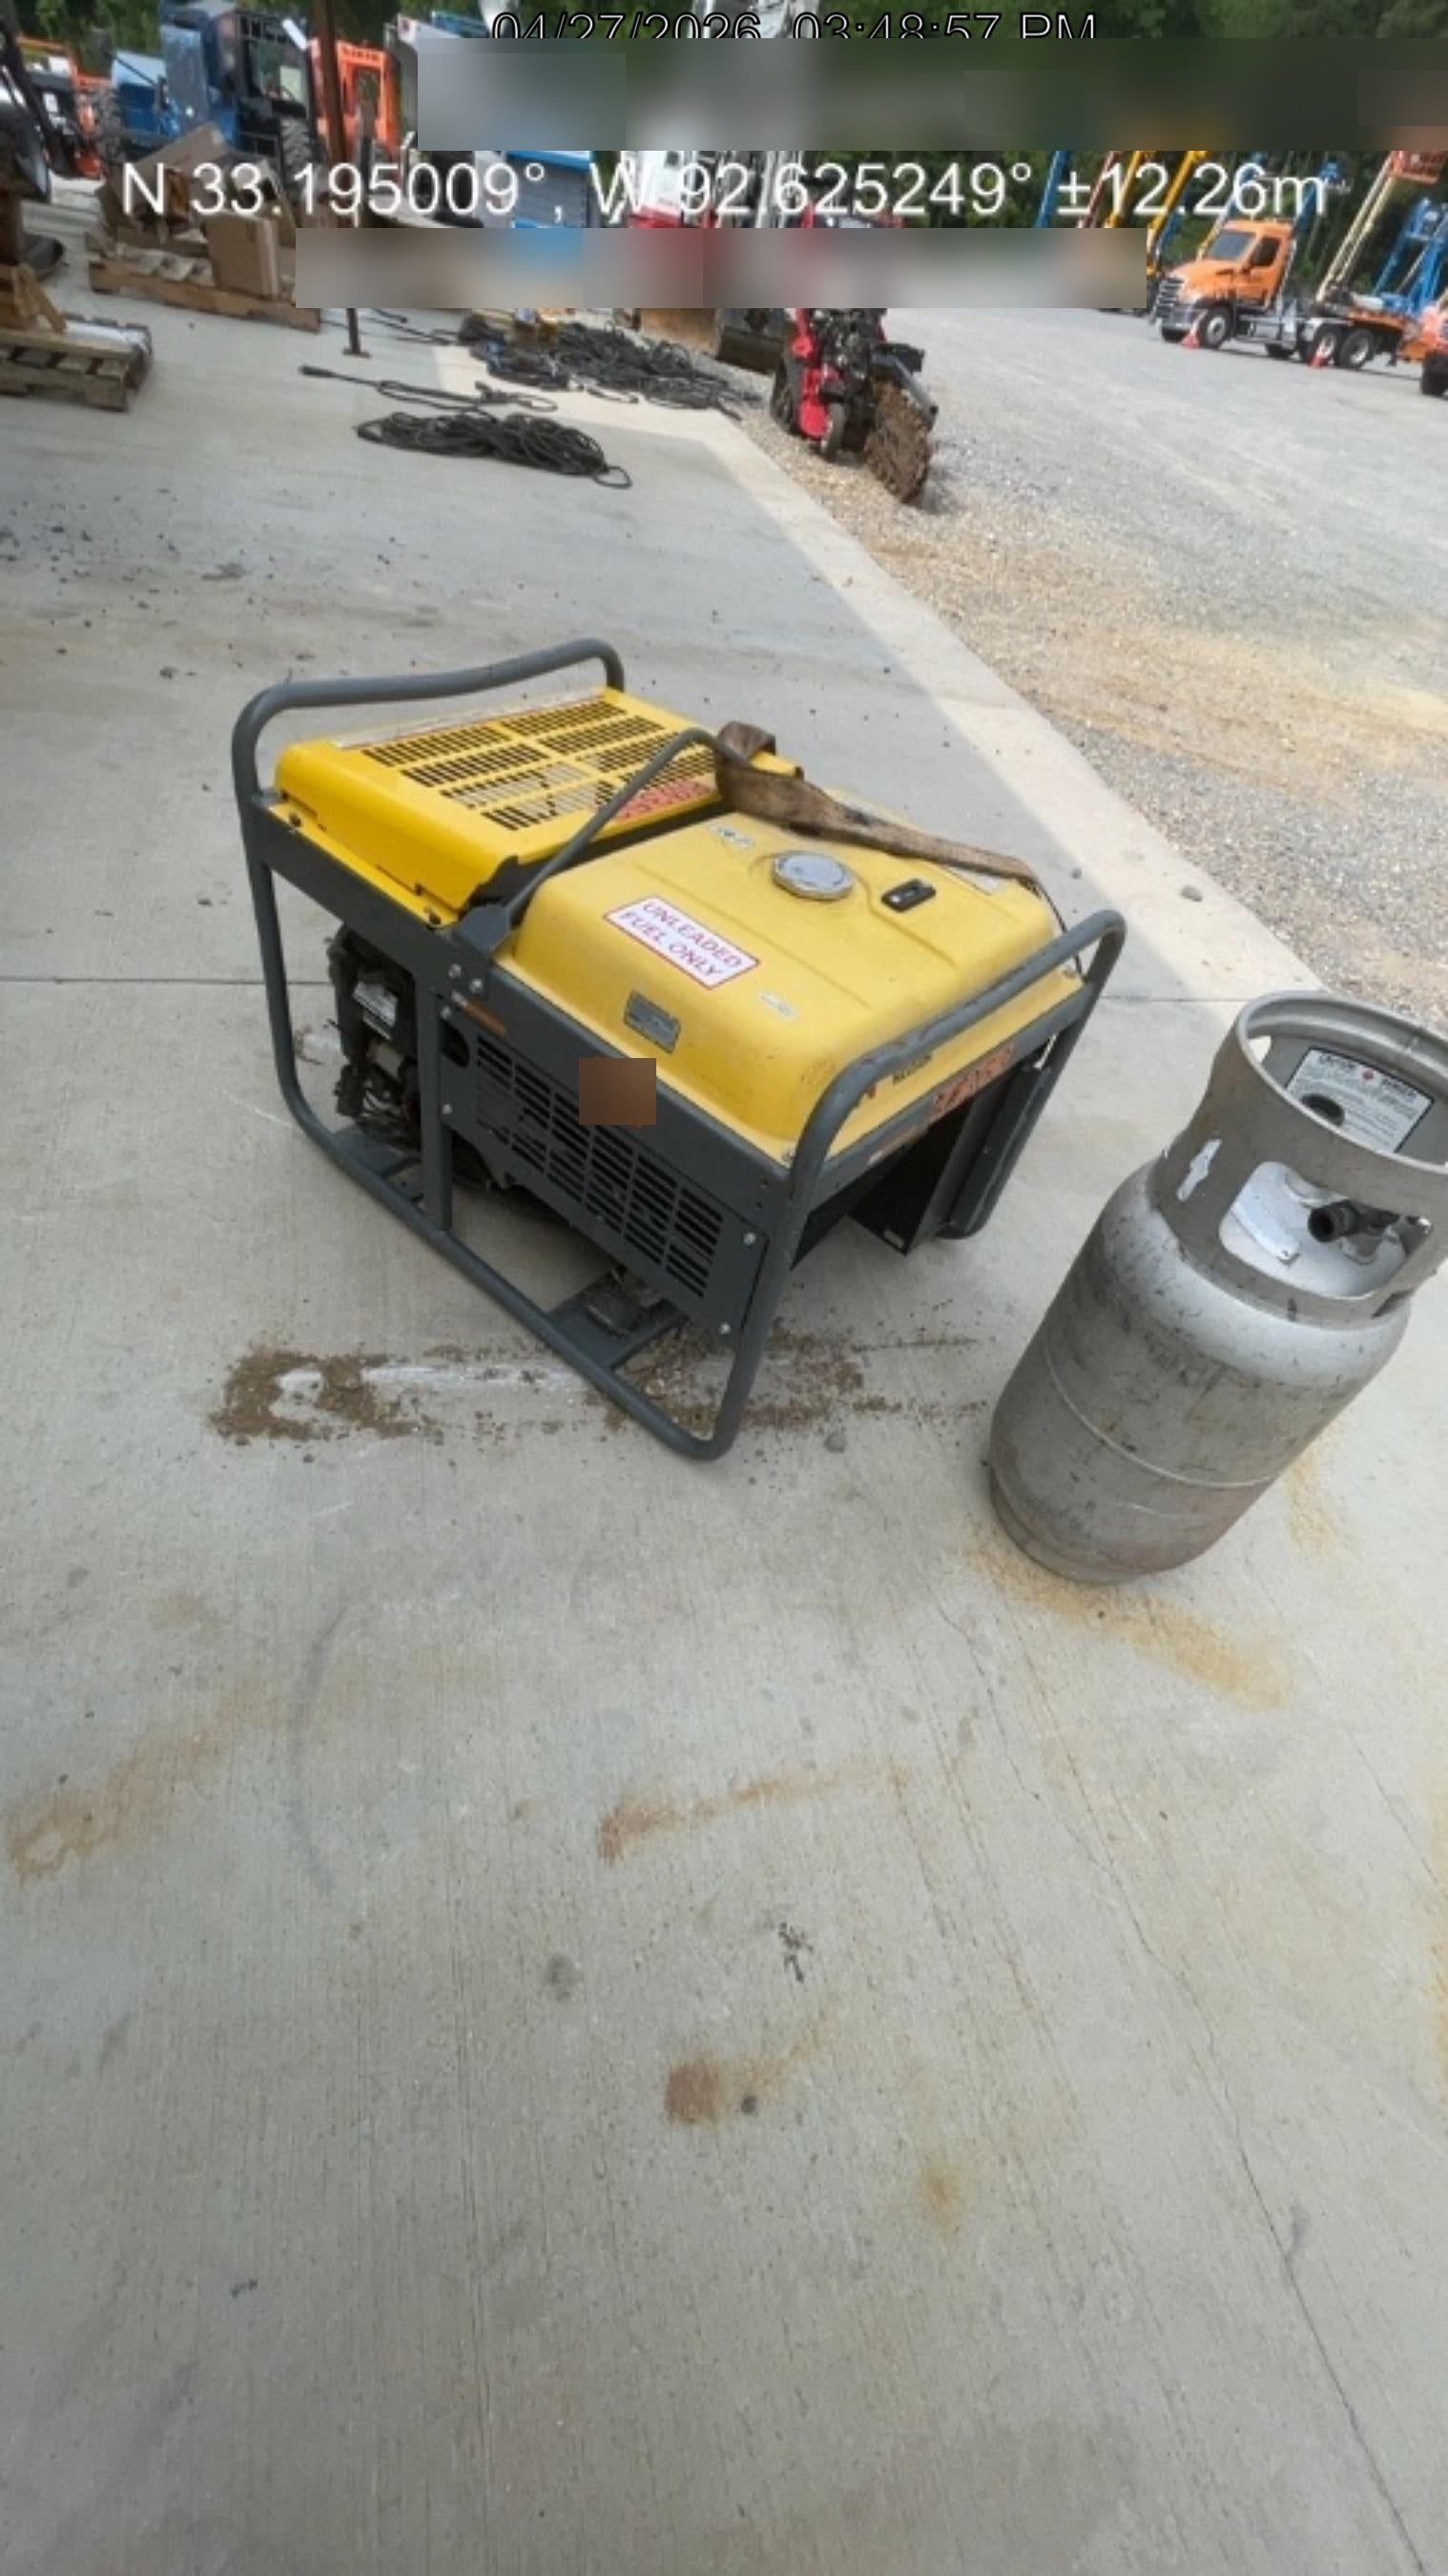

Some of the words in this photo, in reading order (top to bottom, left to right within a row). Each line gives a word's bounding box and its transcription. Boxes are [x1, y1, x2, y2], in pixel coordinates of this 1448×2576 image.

[620, 911, 666, 944] FUEL
[669, 941, 725, 976] ONLY
[643, 902, 742, 967] UNLEADED
